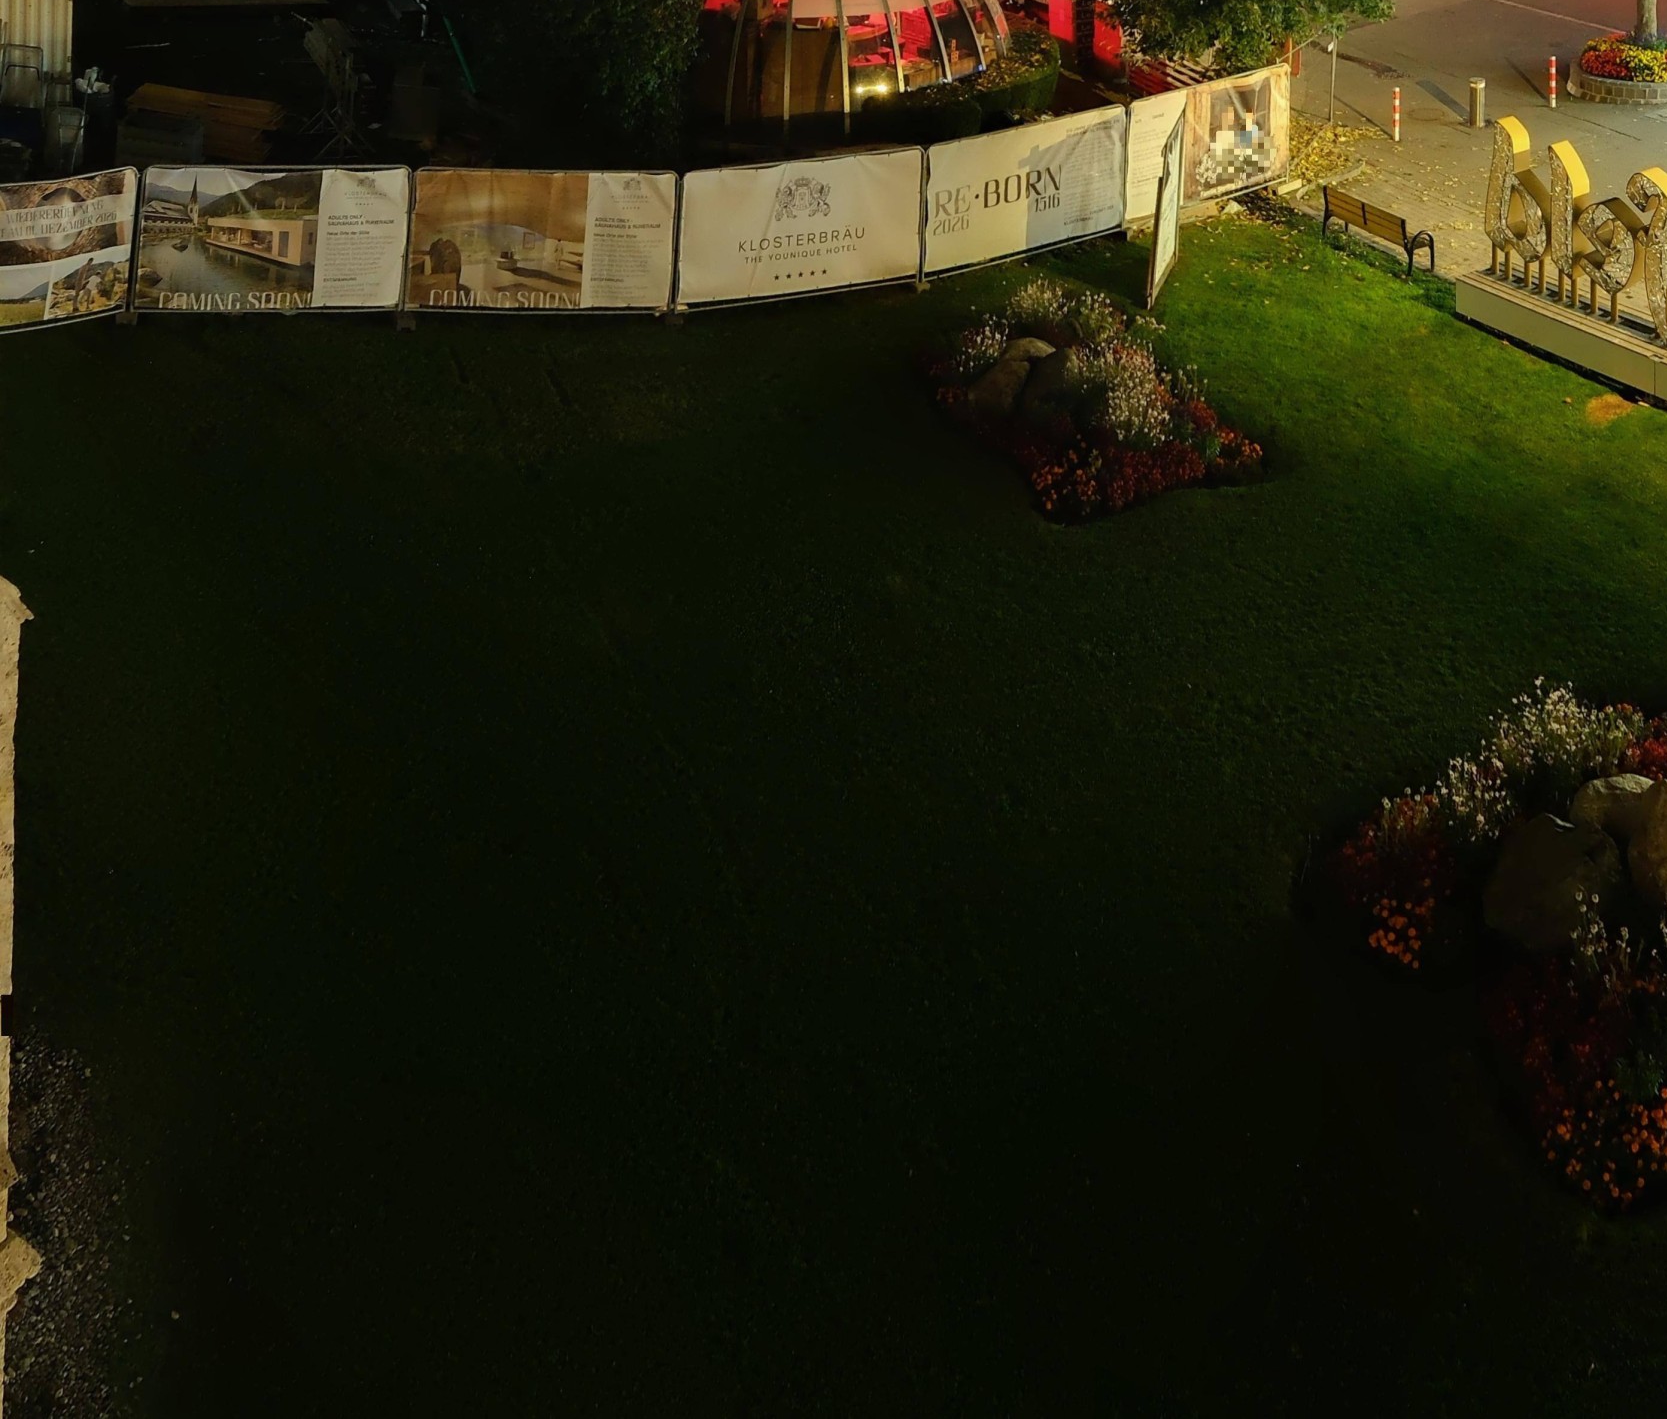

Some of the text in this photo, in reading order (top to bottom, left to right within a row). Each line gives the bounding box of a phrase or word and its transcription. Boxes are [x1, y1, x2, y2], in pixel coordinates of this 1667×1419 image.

[1034, 193, 1061, 212] 1516
[933, 213, 970, 236] 2026
[738, 224, 866, 253] KLOSTERBRÄU
[744, 244, 857, 264] THE YOUNIQUE HOTEL
[159, 291, 242, 310] COMING
[429, 289, 510, 308] COMING
